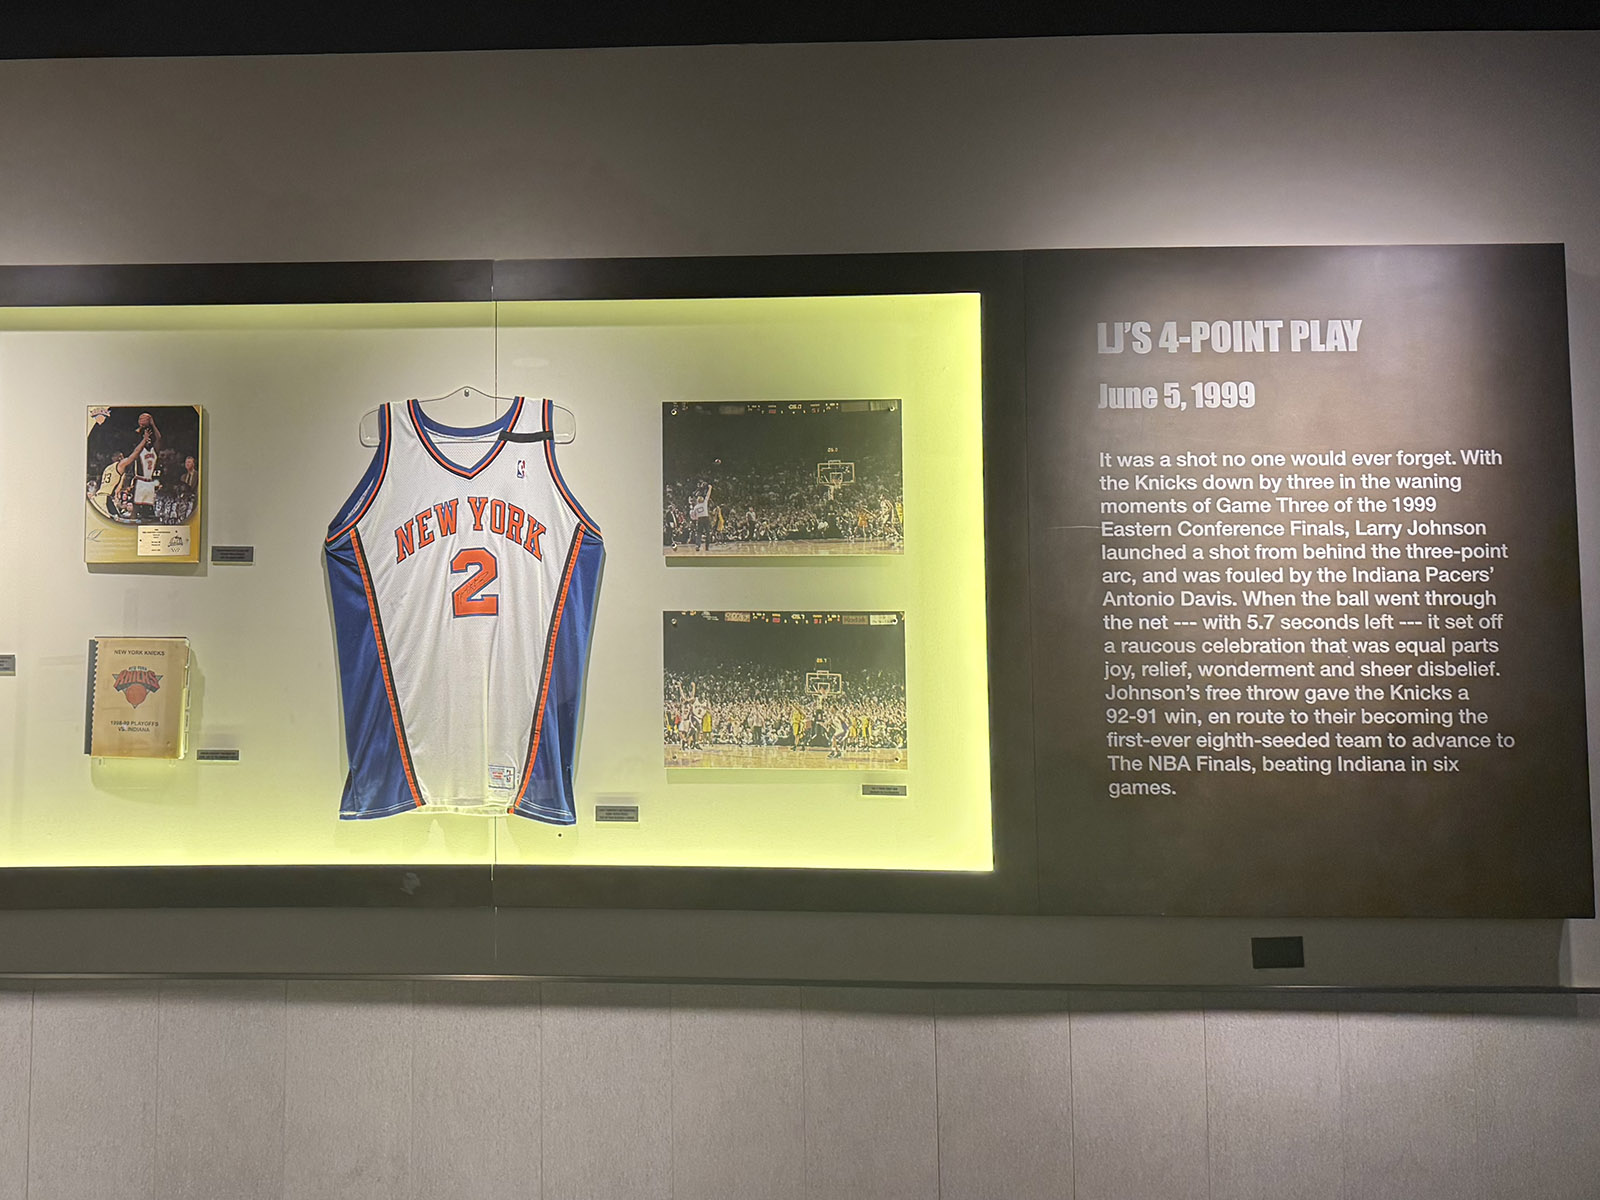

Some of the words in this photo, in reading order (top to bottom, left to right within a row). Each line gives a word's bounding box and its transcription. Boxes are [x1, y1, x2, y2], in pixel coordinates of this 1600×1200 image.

[1158, 320, 1283, 353] 4-POINT
[1290, 320, 1362, 352] PLAY
[1098, 382, 1158, 410] June
[1163, 382, 1187, 411] 5,
[1191, 381, 1256, 408] 1999
[1099, 452, 1113, 468] It
[1116, 455, 1155, 468] was
[1159, 455, 1172, 467] a
[1176, 451, 1218, 467] shot
[1222, 454, 1246, 467] no
[1250, 454, 1286, 467] one
[1290, 450, 1347, 467] would
[1351, 453, 1393, 466] ever
[1395, 449, 1457, 470] forget.
[1459, 449, 1503, 466] With
[1098, 474, 1130, 491] the
[1135, 474, 1198, 491] Knicks
[1202, 473, 1254, 490] down
[1259, 473, 1283, 494] by
[1286, 473, 1335, 490] three
[1339, 473, 1356, 490] in
[1359, 473, 1391, 490] the
[1394, 472, 1462, 493] waning
[1100, 498, 1188, 514] moments
[1192, 497, 1212, 514] of
[1216, 497, 1272, 514] Game
[1275, 497, 1330, 513] Three
[1333, 496, 1353, 513] of
[1356, 496, 1388, 513] the
[1391, 496, 1437, 513] 1999
[394, 497, 459, 564] NEW
[467, 496, 547, 562] YORK
[1100, 521, 1172, 537] Eastern
[1177, 520, 1285, 537] Conference
[1290, 519, 1350, 539] Finals,
[1355, 519, 1403, 540] Larry
[1406, 519, 1487, 536] Johnson
[1101, 543, 1187, 561] launched
[1192, 547, 1205, 560] a
[1208, 543, 1251, 560] shot
[1254, 543, 1298, 560] from
[1302, 543, 1366, 560] behind
[1370, 543, 1402, 560] the
[1404, 542, 1509, 563] three-point
[450, 547, 499, 618] 2
[1102, 571, 1137, 586] arc,
[1142, 567, 1178, 584] and
[1182, 570, 1221, 584] was
[1224, 566, 1284, 584] fouled
[1289, 566, 1313, 587] by
[1316, 566, 1348, 583] the
[1352, 566, 1421, 583] Indiana
[1102, 590, 1175, 607] Antonio
[1180, 590, 1238, 607] Davis.
[1241, 590, 1296, 607] When
[1300, 590, 1332, 607] the
[1336, 589, 1370, 607] ball
[1374, 590, 1421, 607] went
[1424, 589, 1497, 610] through
[1102, 614, 1134, 630] the
[1138, 614, 1169, 630] net
[1202, 613, 1242, 630] with
[1246, 614, 1276, 630] 5.7
[1280, 613, 1360, 630] seconds
[1364, 613, 1395, 630] left
[1427, 613, 1441, 630] it
[1444, 613, 1474, 630] set
[1478, 613, 1504, 630] off
[1103, 641, 1117, 654] a
[1121, 641, 1197, 654] raucous
[1201, 637, 1306, 654] celebration
[1309, 637, 1351, 655] that
[1351, 640, 1391, 654] was
[1394, 636, 1446, 657] equal
[1451, 637, 1500, 657] parts
[114, 669, 160, 690] KNICKS
[1103, 660, 1136, 681] joy,
[1141, 660, 1193, 680] relief,
[1197, 660, 1316, 677] wonderment
[1319, 661, 1355, 677] and
[1360, 660, 1413, 677] sheer
[1416, 660, 1501, 677] disbelief.
[1204, 684, 1242, 701] free
[1245, 684, 1300, 701] throw
[1304, 688, 1350, 705] gave
[1353, 684, 1385, 701] the
[1390, 684, 1453, 701] Knicks
[1457, 688, 1470, 701] a
[1105, 707, 1156, 724] 92-91
[1164, 707, 1203, 727] win,
[1208, 711, 1231, 725] en
[1236, 708, 1285, 725] route
[1288, 708, 1309, 725] to
[1312, 708, 1357, 725] their
[1360, 707, 1454, 728] becoming
[1457, 708, 1489, 725] the
[1106, 731, 1192, 748] first-ever
[1196, 731, 1330, 752] eighth-seeded
[1334, 732, 1383, 749] team
[1386, 732, 1407, 748] to
[1411, 731, 1492, 748] advance
[1495, 732, 1516, 748] to
[1106, 755, 1143, 772] The
[1148, 755, 1192, 772] NBA
[1196, 755, 1257, 775] Finals,
[1262, 755, 1332, 776] beating
[1337, 755, 1407, 772] Indiana
[1410, 755, 1428, 772] in
[1433, 755, 1460, 772] six
[1108, 782, 1177, 799] games.
